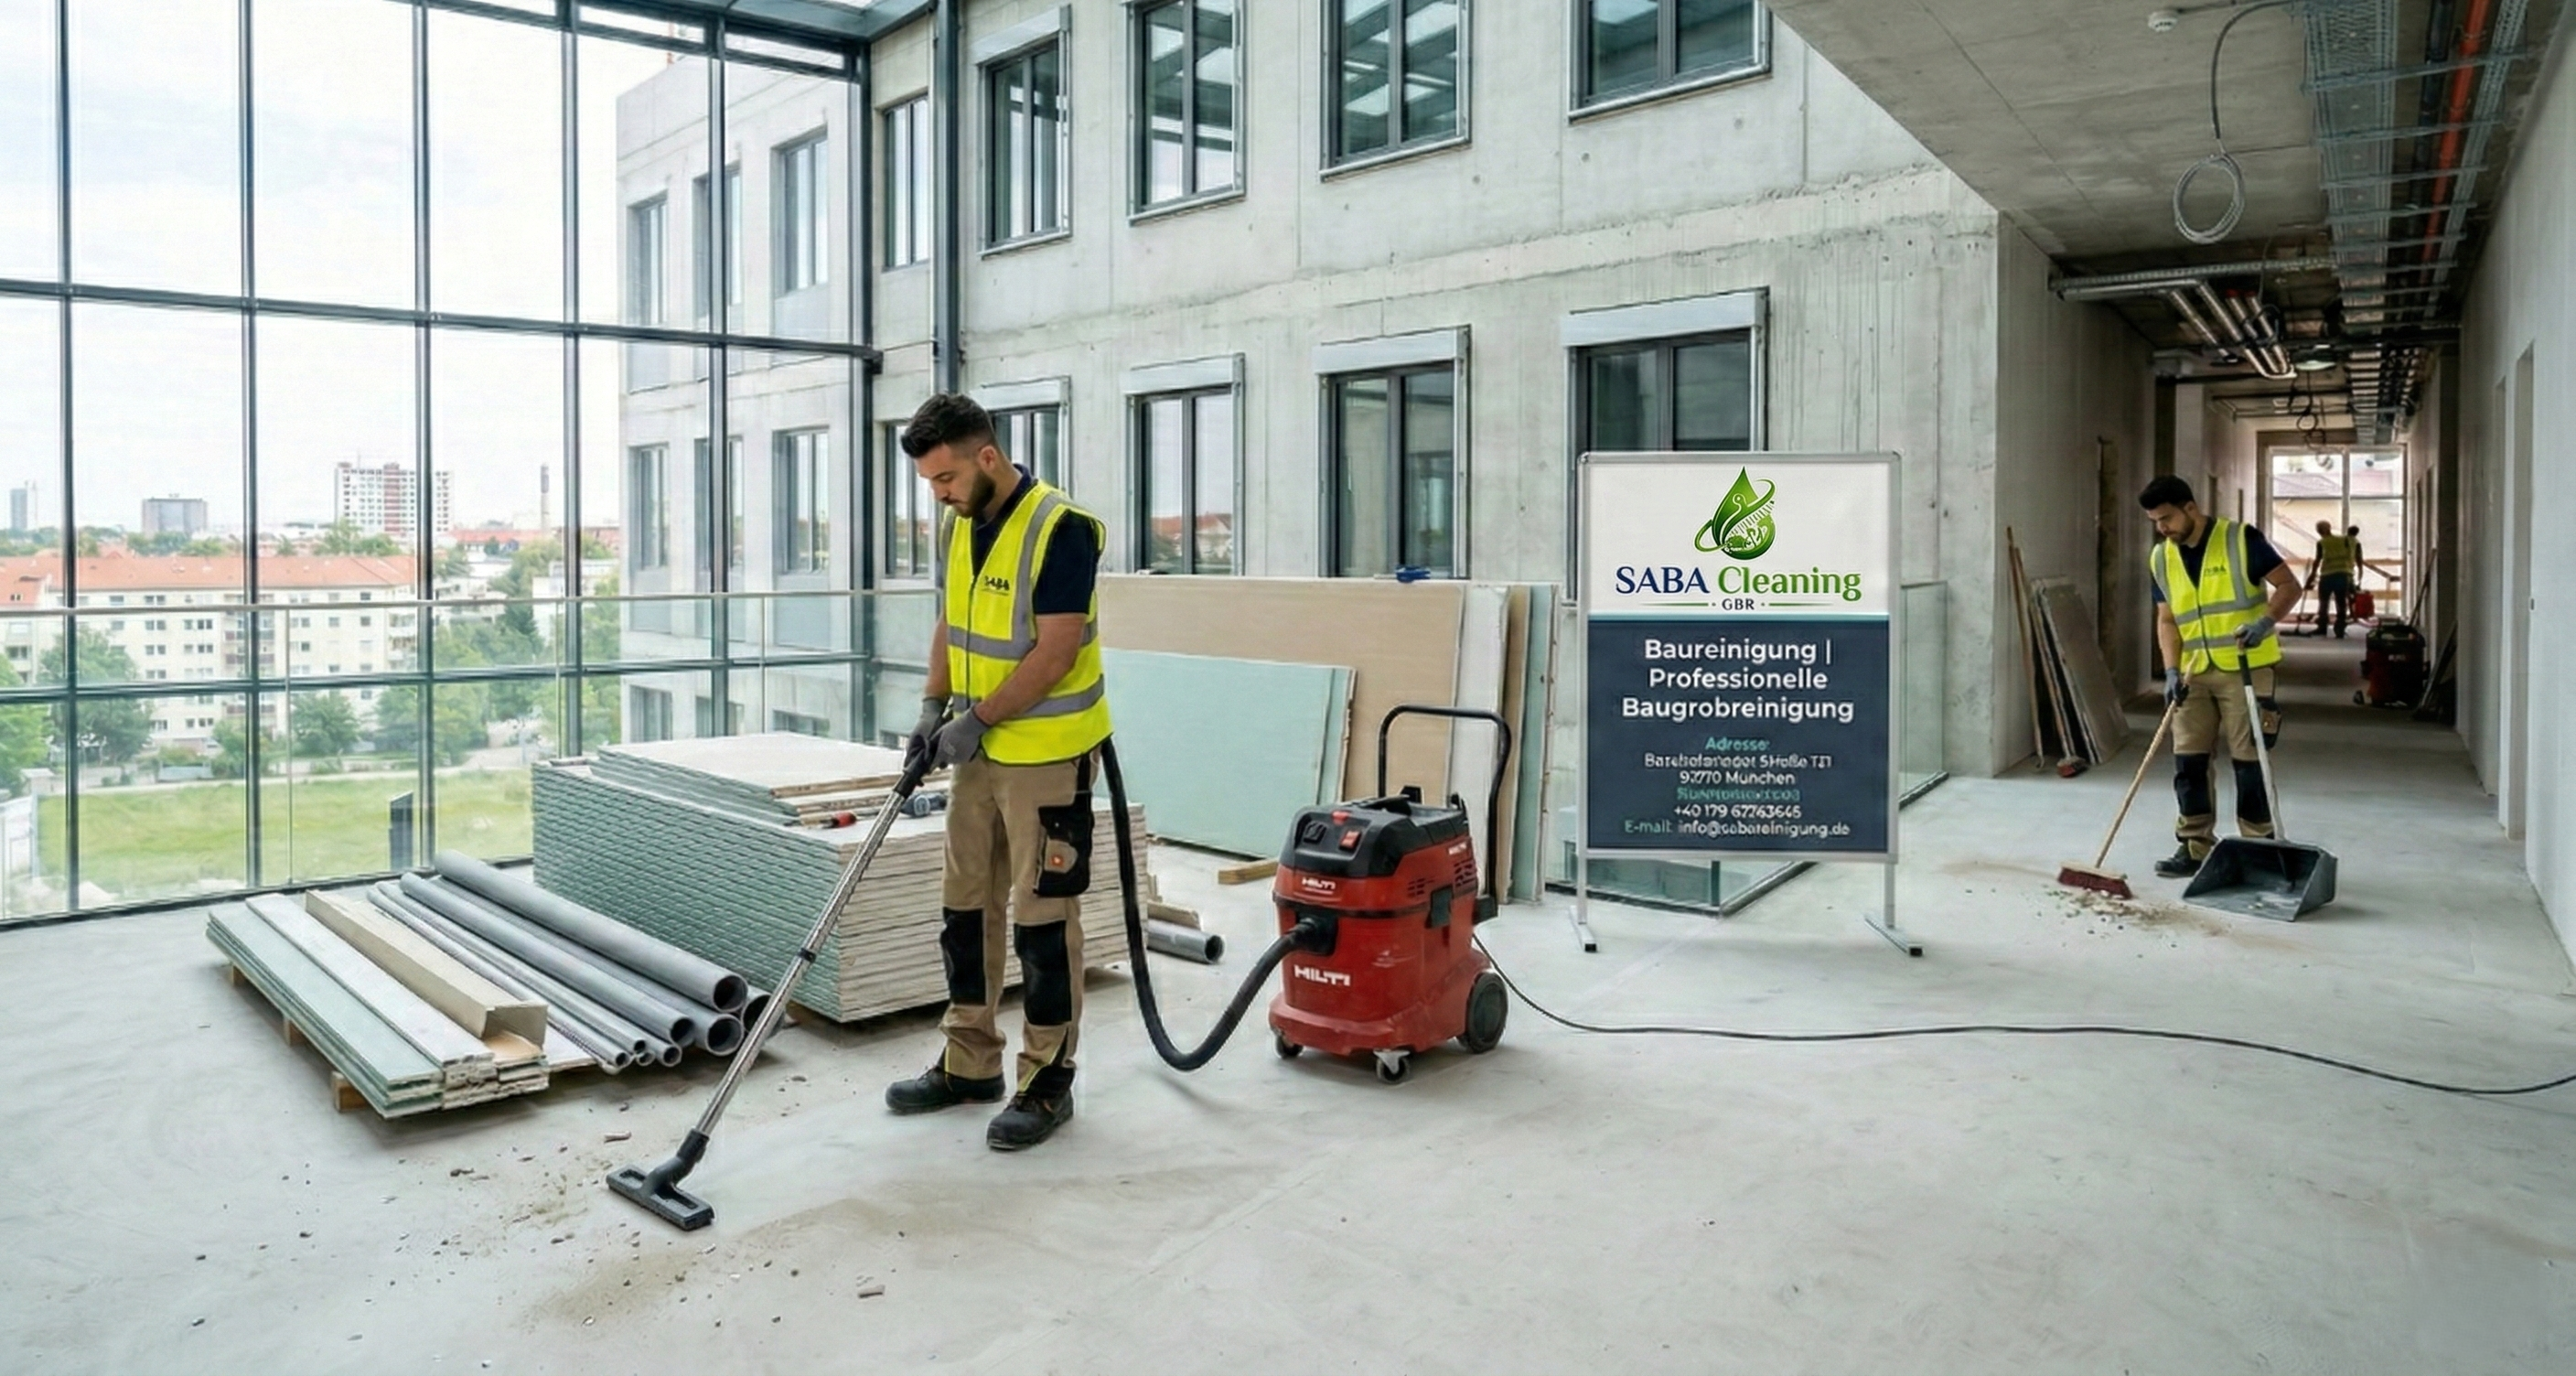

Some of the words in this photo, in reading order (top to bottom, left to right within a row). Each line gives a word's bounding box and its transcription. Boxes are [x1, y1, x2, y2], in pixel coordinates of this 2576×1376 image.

[1615, 566, 1710, 595] SABA
[1718, 565, 1862, 602] Cleaning
[1722, 598, 1755, 610] GBR
[1644, 638, 1817, 665] Baureinigung
[1649, 667, 1828, 688] Professionelle
[1622, 696, 1854, 723] Baugrobreinigung
[1293, 964, 1351, 987] HILTI
